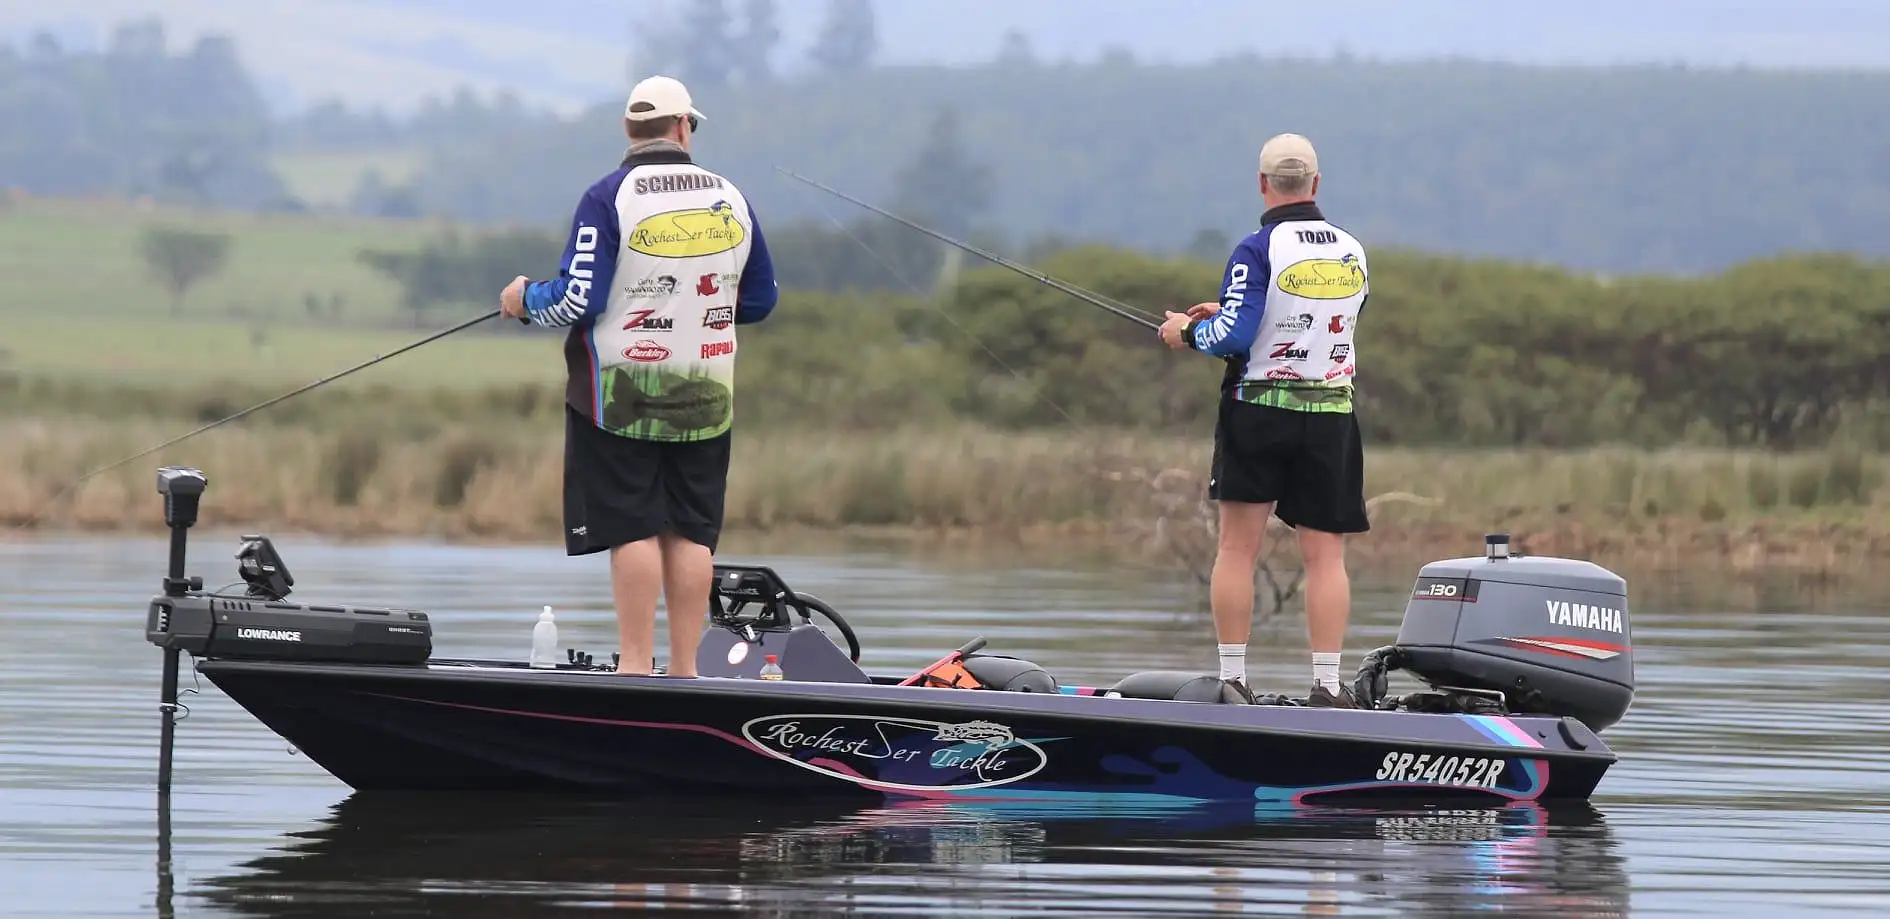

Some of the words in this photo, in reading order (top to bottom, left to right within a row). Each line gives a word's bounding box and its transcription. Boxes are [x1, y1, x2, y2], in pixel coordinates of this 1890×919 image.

[634, 174, 724, 195] SCHMIDT
[1295, 231, 1338, 244] TODD
[705, 308, 731, 324] BOSS
[628, 348, 666, 360] Berkley
[1430, 584, 1457, 597] 130
[1546, 600, 1623, 634] YAMAHA
[238, 628, 301, 642] LOWRANCE
[930, 748, 1009, 782] Tackle
[1375, 751, 1506, 789] SR54052R
